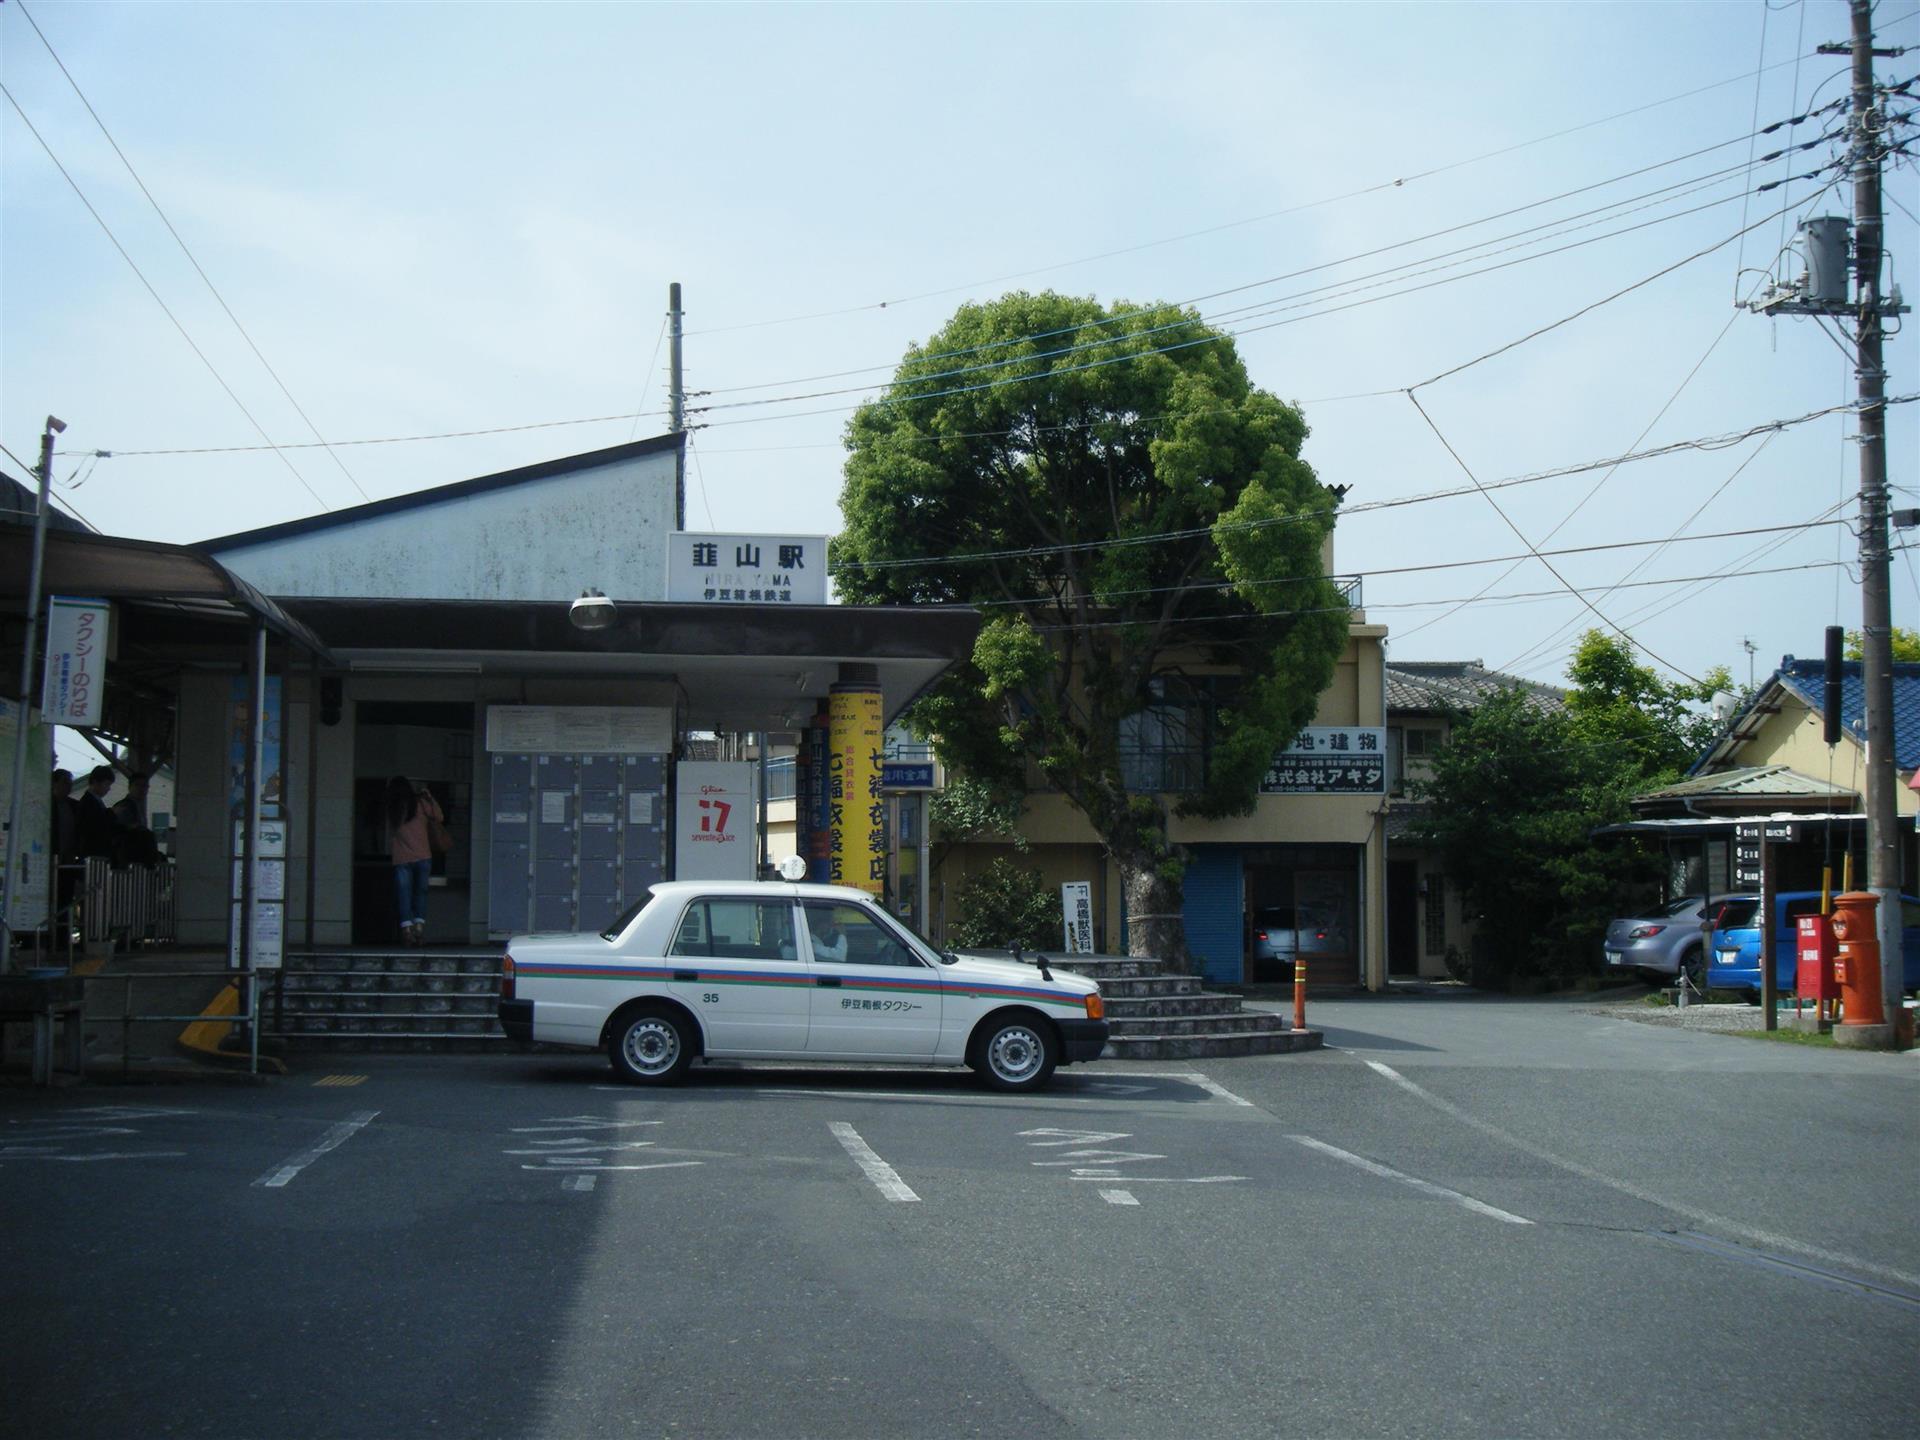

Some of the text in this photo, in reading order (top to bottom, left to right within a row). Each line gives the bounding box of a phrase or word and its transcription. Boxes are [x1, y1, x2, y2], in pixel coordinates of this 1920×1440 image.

[693, 542, 804, 569] 韮山駅
[704, 588, 791, 602] 伊豆箱根鉄道
[69, 612, 95, 717] タクシーのりば
[703, 993, 719, 1003] 35
[841, 998, 922, 1012] 伊豆箱根タクシー
